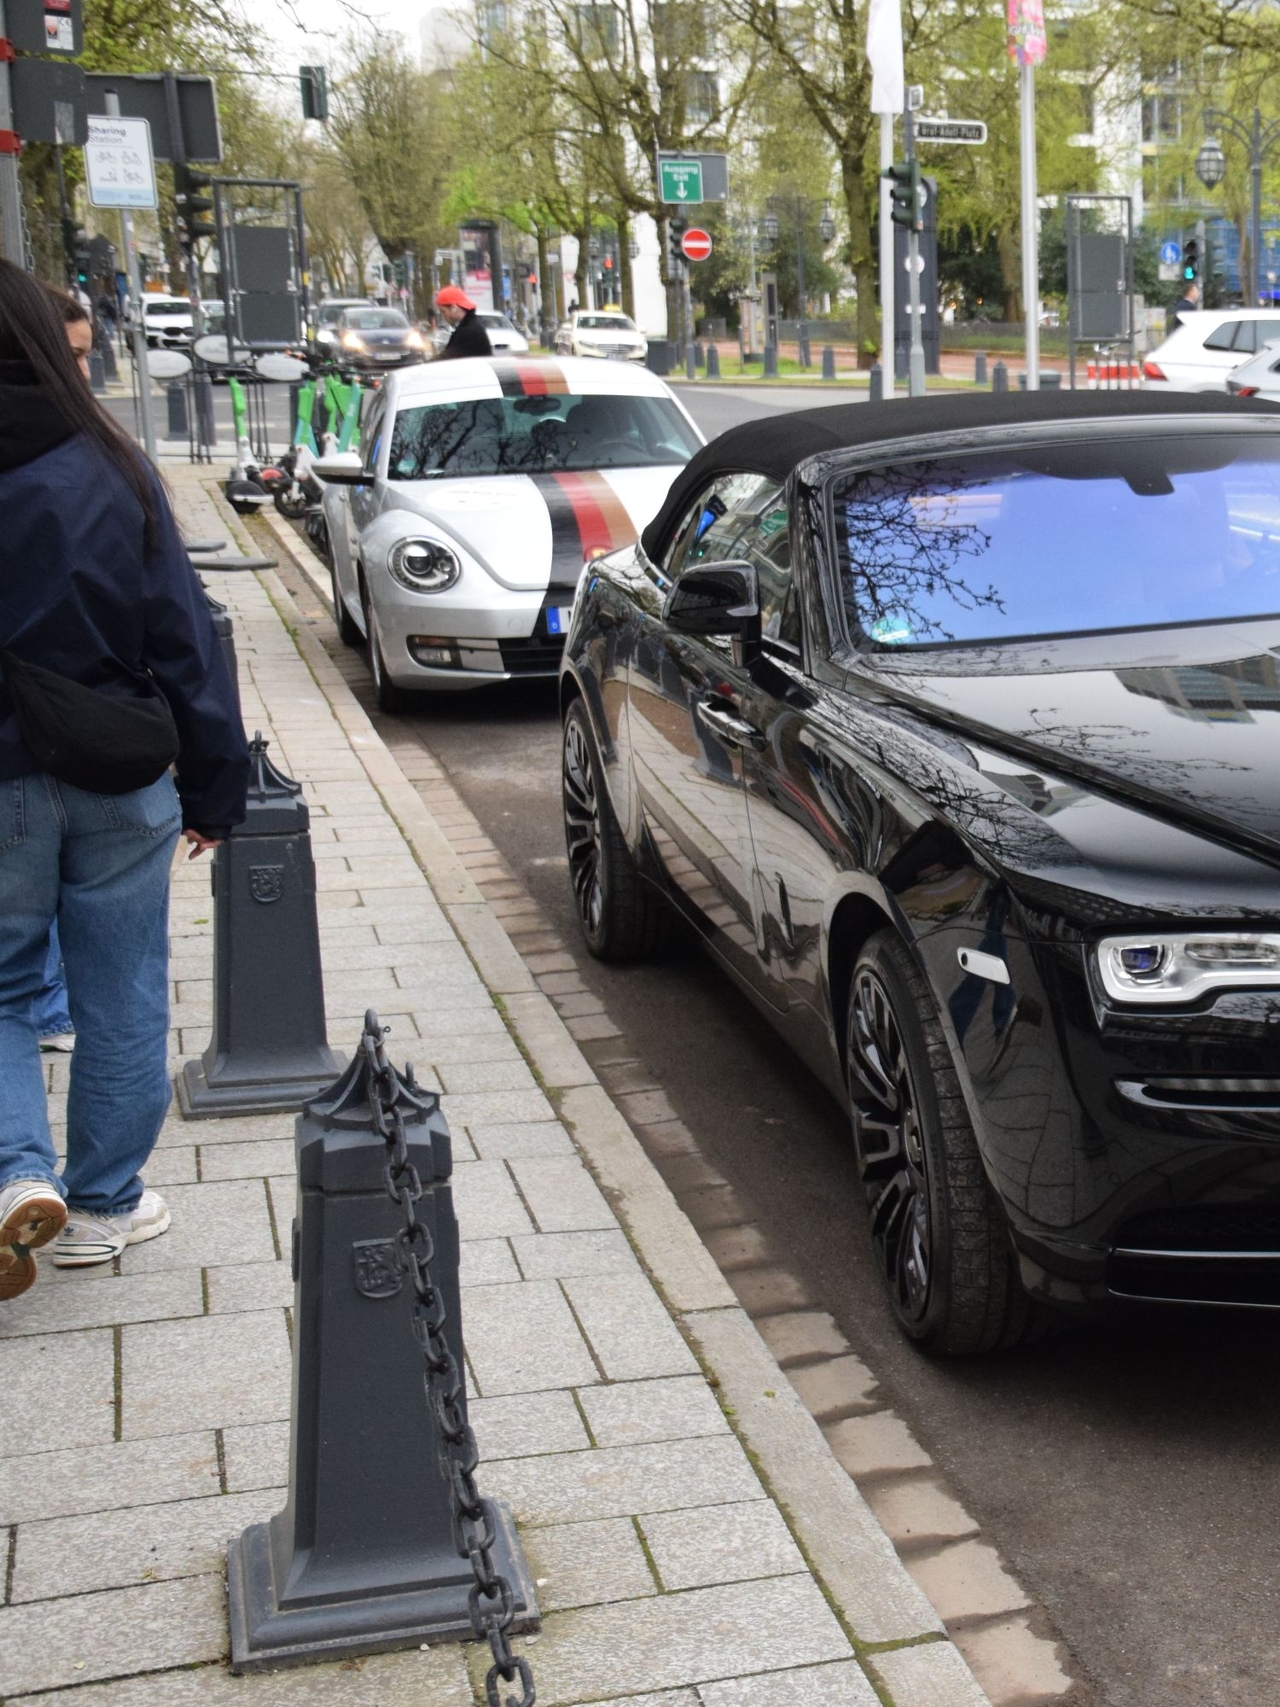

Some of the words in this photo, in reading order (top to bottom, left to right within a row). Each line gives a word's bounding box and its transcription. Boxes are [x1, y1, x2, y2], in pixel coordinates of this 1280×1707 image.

[88, 125, 126, 137] Sharing
[89, 135, 123, 144] Station
[664, 164, 698, 174] Ausgang
